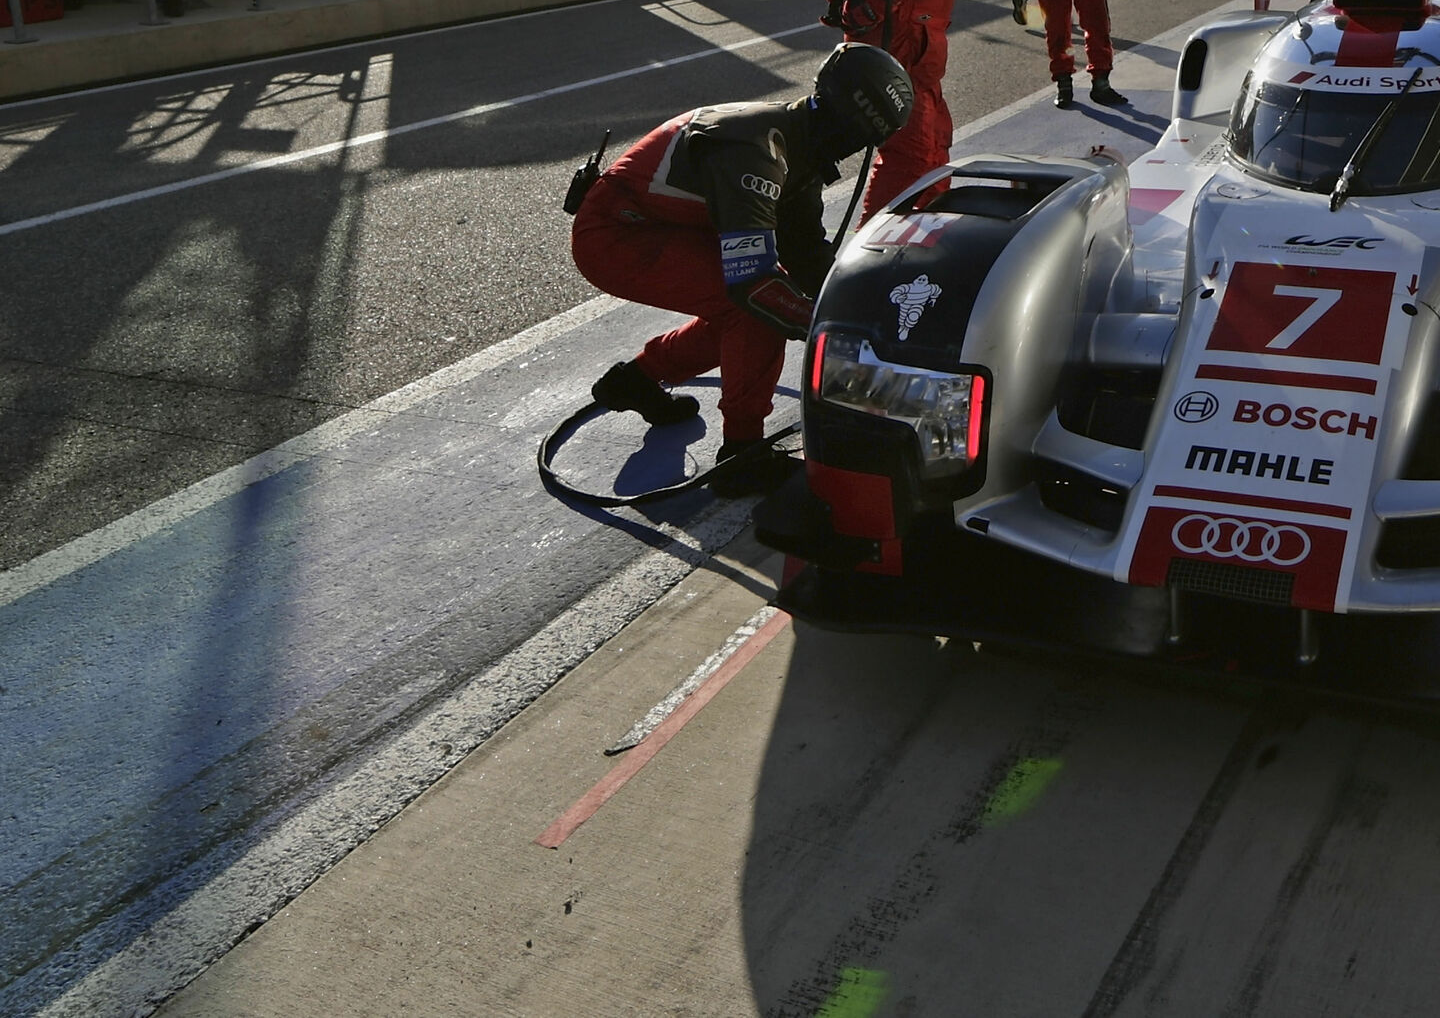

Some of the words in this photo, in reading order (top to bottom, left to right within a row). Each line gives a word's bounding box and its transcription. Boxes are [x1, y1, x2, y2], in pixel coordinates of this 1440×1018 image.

[1315, 74, 1371, 87] Audi
[886, 84, 905, 112] uvex
[853, 89, 894, 137] uvex
[866, 213, 963, 243] HY
[1284, 235, 1385, 250] WEC
[723, 237, 763, 251] WEC
[736, 267, 756, 276] LANE
[1265, 285, 1343, 349] 7
[1232, 399, 1378, 440] BOSCH
[1184, 445, 1334, 485] MAHLE
